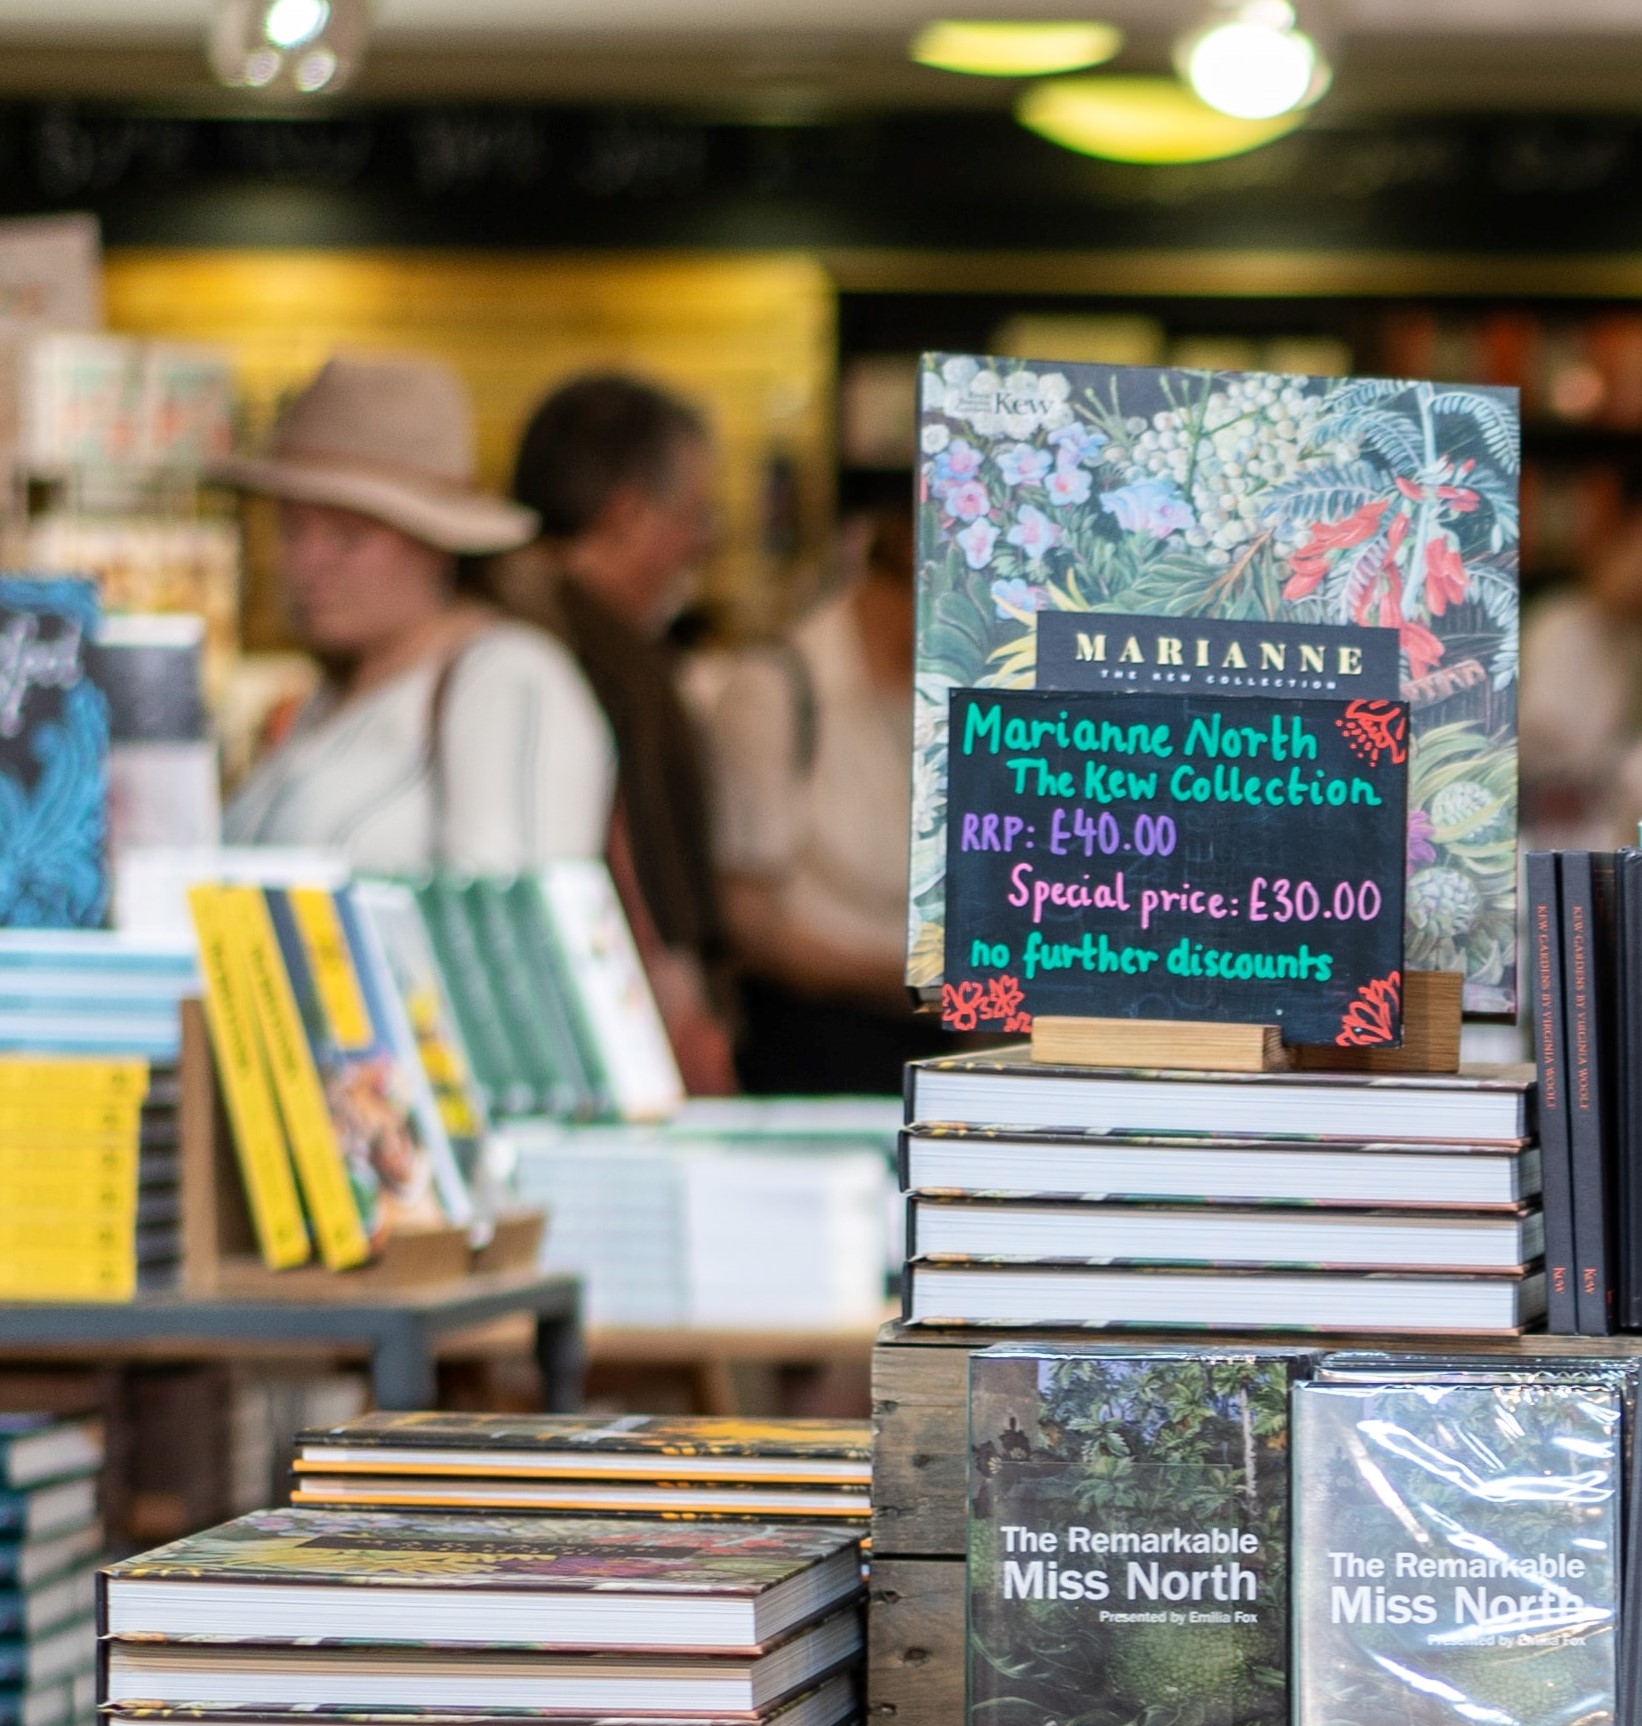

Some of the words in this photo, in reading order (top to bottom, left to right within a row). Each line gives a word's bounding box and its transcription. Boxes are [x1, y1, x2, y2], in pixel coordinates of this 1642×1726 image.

[994, 392, 1053, 415] Kew
[1075, 632, 1363, 675] MARIANNE
[1101, 669, 1138, 680] THE
[1152, 672, 1192, 683] KEW
[1205, 675, 1337, 690] COLLECTION
[962, 702, 1174, 758] Marianne
[1184, 713, 1317, 761] North
[1006, 757, 1075, 799] The
[1085, 759, 1157, 804] Kew
[1171, 764, 1382, 806] Collection
[962, 813, 1036, 853] RRP:
[1050, 808, 1177, 857] £40.00
[1008, 863, 1130, 924] Special
[1140, 883, 1239, 930] price:
[1249, 877, 1382, 923] £30.00
[971, 939, 1009, 968] no
[1023, 932, 1159, 980] further
[1166, 938, 1333, 981] discounts
[1574, 935, 1586, 991] GARDENS
[1577, 1012, 1588, 1065] VIRGINIA
[1578, 1067, 1590, 1110] WOOLF
[1582, 1267, 1596, 1296] Kew
[1000, 1526, 1058, 1553] The
[1069, 1526, 1260, 1554] Remarkable
[1003, 1561, 1110, 1601] Miss
[1127, 1561, 1257, 1601] North
[1328, 1552, 1385, 1578] The
[1396, 1552, 1587, 1579] Remarkable
[1100, 1611, 1167, 1623] Presented
[1170, 1611, 1186, 1626] by
[1189, 1611, 1231, 1624] Emilia
[1234, 1612, 1259, 1624] Fox
[1331, 1586, 1438, 1624] Miss
